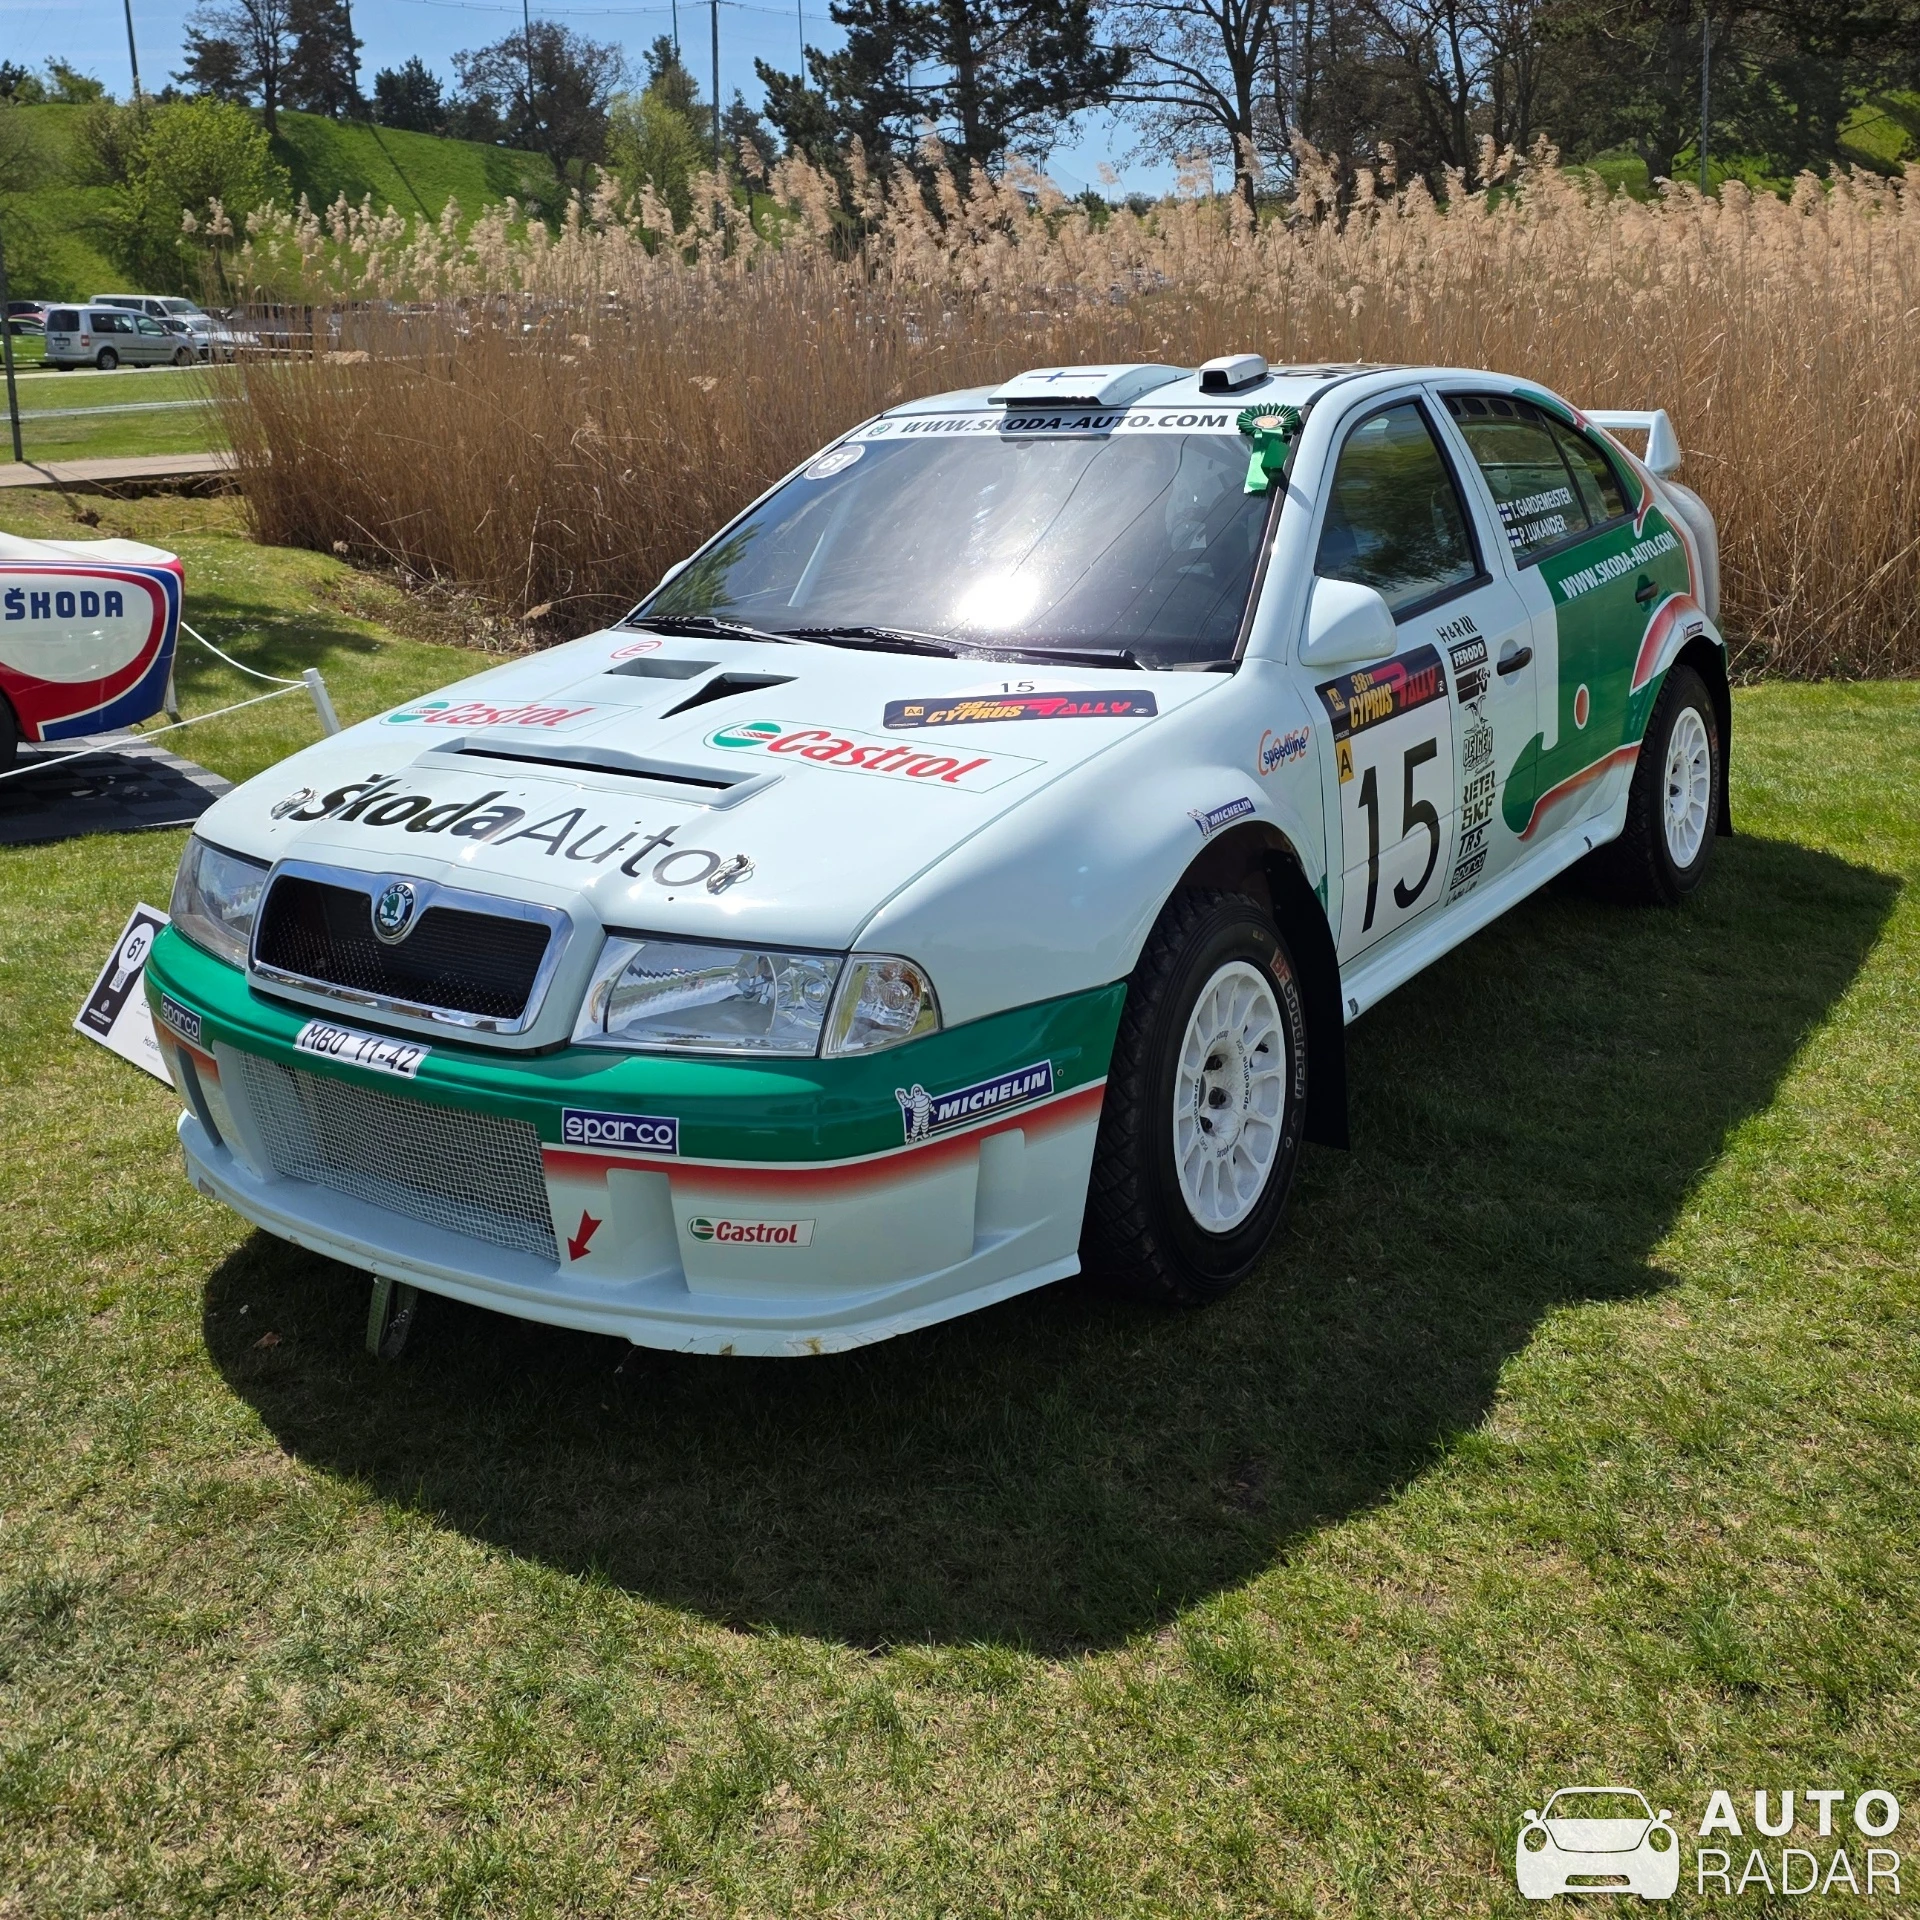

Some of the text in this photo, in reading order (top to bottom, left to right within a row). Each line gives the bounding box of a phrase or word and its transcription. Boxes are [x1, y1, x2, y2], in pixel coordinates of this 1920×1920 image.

[899, 414, 1229, 435] WWW.SKODA-AUTO.COM
[817, 453, 855, 471] 61
[1558, 530, 1679, 600] WWW.SKODA-AUTO.COM
[4, 587, 124, 621] ŠKODA
[1453, 642, 1485, 667] FERODO
[1001, 680, 1035, 693] 15
[1348, 661, 1437, 729] CYPRUS RALLY
[1350, 672, 1375, 693] 38TH
[427, 703, 596, 727] Castrol
[925, 697, 1132, 723] CYPRUS RALLY
[766, 730, 995, 783] Castrol
[1262, 736, 1306, 768] speedline
[1340, 748, 1352, 777] A
[1210, 799, 1252, 825] MICHELIN
[1461, 792, 1496, 831] SKF
[1357, 736, 1441, 934] 15
[1458, 823, 1486, 857] TRS
[1452, 853, 1486, 884] sparco
[127, 936, 147, 962] 61
[162, 1001, 199, 1037] sparco
[301, 1024, 420, 1073] MBO 11-42
[937, 1069, 1047, 1122] MICHELIN
[1242, 1055, 1250, 1111] speedline
[564, 1116, 673, 1145] sparco
[715, 1219, 798, 1245] Castrol
